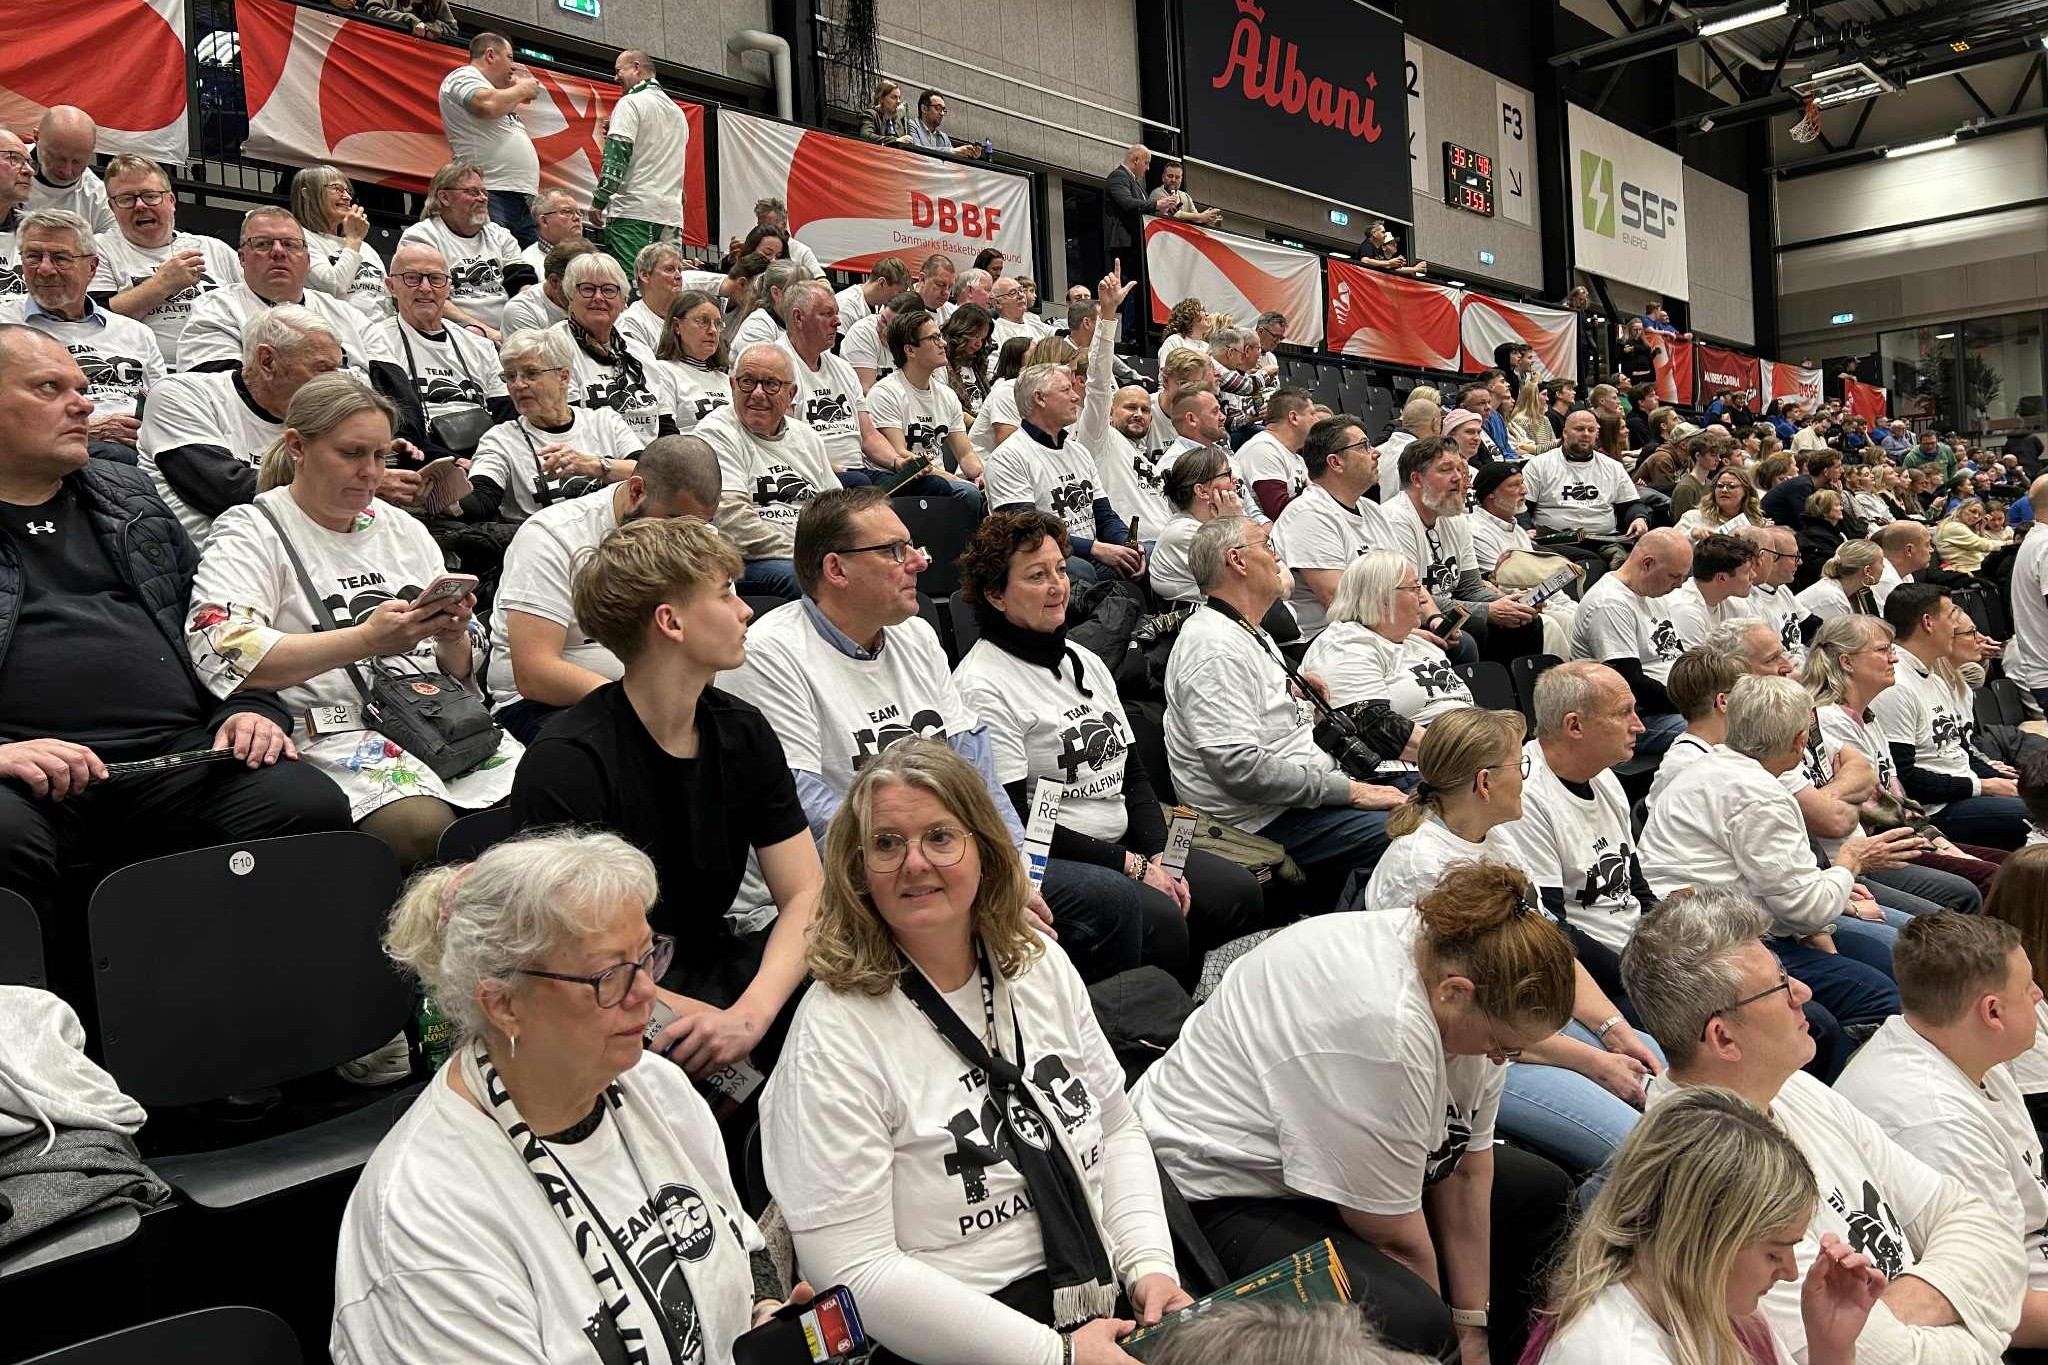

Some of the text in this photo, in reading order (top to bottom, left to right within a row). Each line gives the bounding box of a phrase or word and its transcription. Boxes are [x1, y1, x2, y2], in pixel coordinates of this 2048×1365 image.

[1212, 18, 1382, 143] Albani
[1405, 61, 1420, 98] 2
[1503, 102, 1523, 140] F3
[911, 190, 1001, 241] DBBF
[1621, 181, 1677, 239] SEF
[893, 230, 940, 250] Danmarks
[67, 345, 97, 355] EAM
[425, 367, 457, 376] TEAM
[1562, 485, 1599, 500] FOG
[758, 508, 800, 520] POKALF
[337, 572, 387, 590] TEAM
[334, 705, 349, 725] Re
[867, 705, 900, 723] EAM
[1042, 788, 1060, 803] Kva
[1038, 801, 1058, 820] Re
[1173, 835, 1191, 849] Re
[232, 856, 252, 870] F10
[959, 1066, 986, 1093] TE
[613, 1196, 658, 1251] EAM
[659, 1196, 708, 1247] FOG
[821, 1298, 838, 1312] VISA
